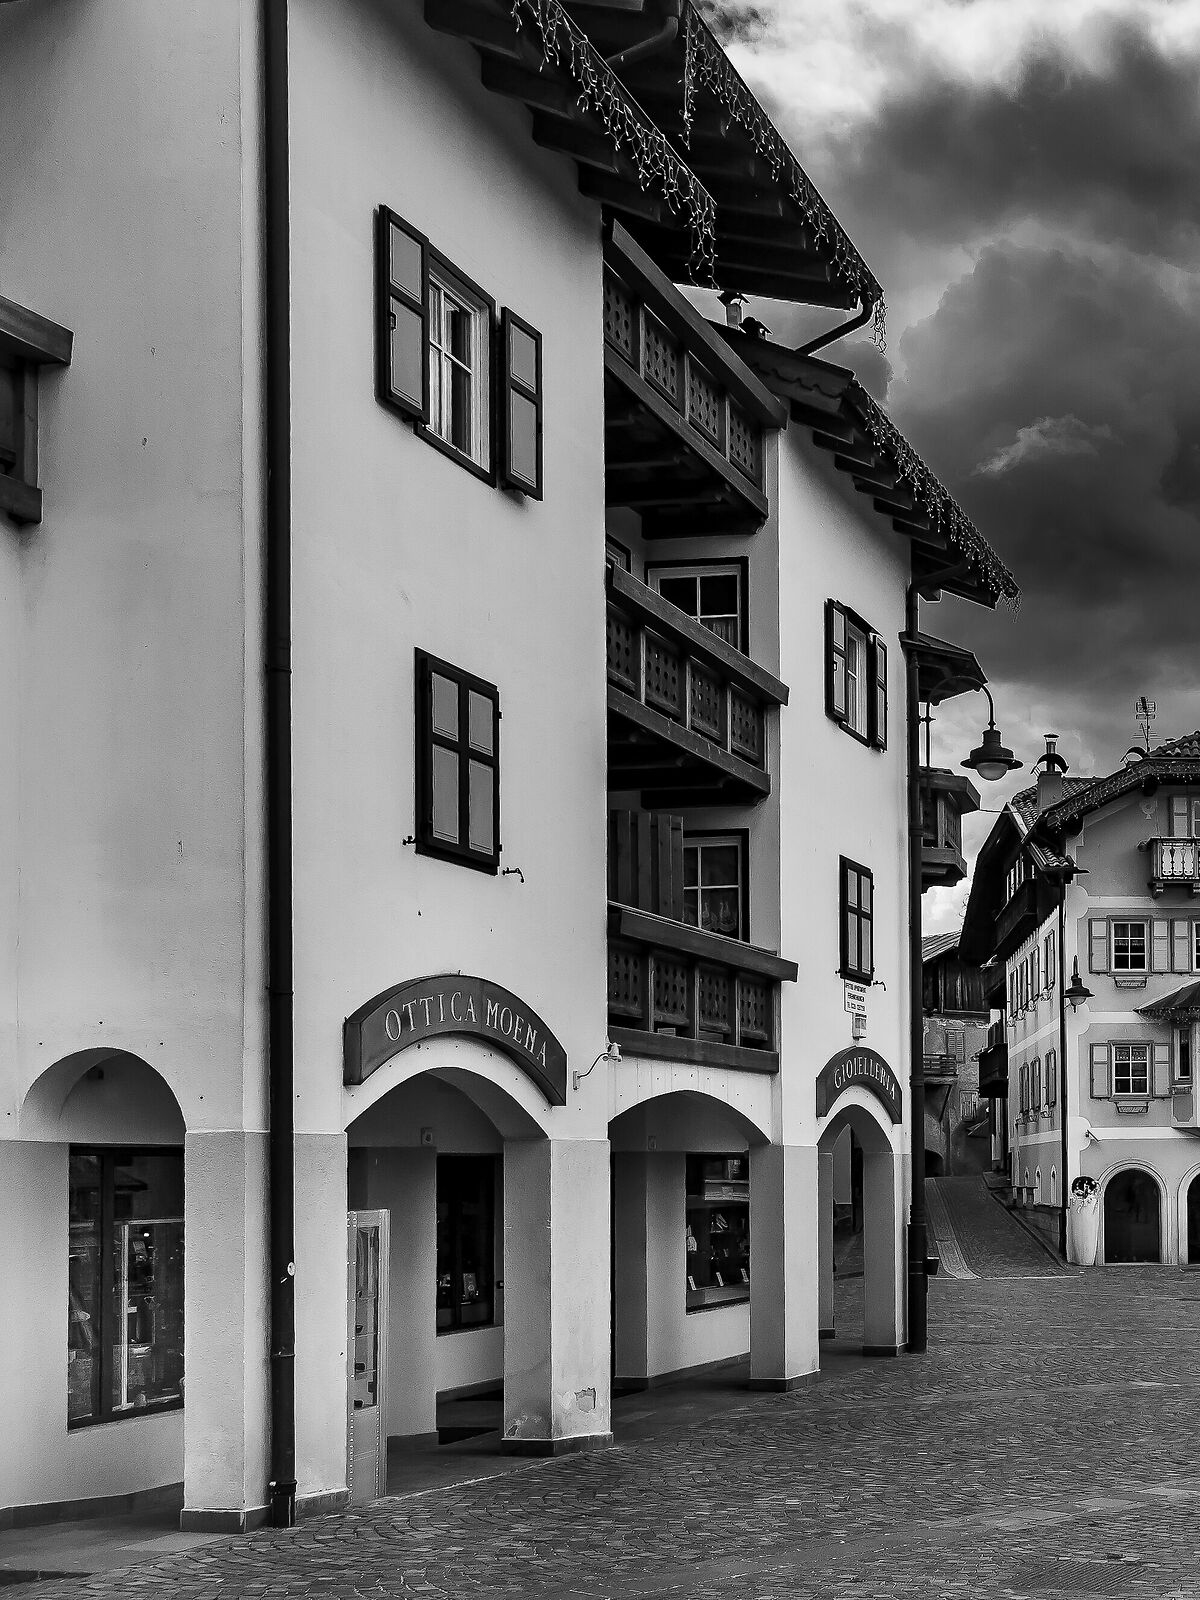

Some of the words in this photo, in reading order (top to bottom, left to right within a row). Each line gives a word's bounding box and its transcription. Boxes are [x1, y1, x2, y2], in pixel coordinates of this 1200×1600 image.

[385, 991, 477, 1041] OTTICA
[485, 998, 547, 1068] MOENA
[834, 1056, 895, 1100] GIOIELLERIA
